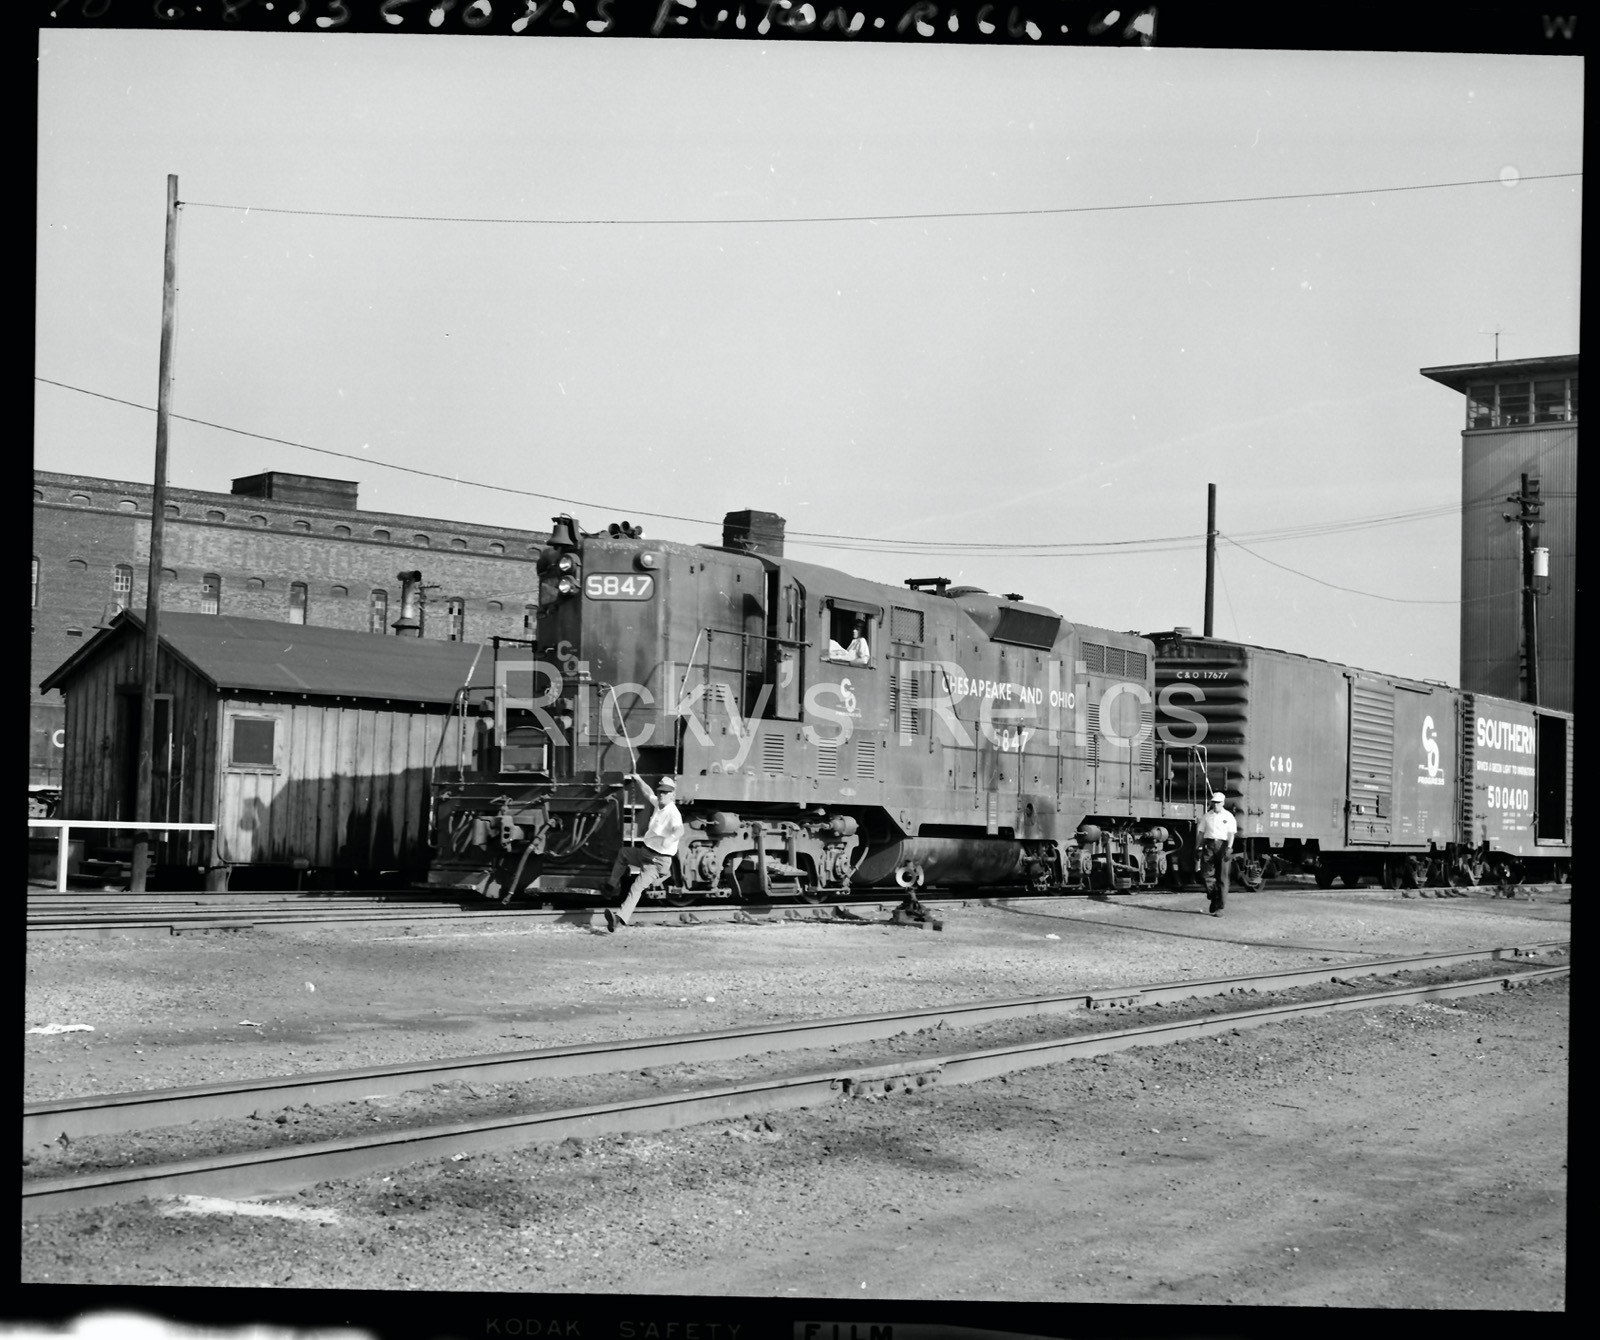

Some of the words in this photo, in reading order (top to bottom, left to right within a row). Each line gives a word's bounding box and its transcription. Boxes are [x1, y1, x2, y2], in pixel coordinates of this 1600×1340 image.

[1541, 14, 1578, 40] W
[587, 575, 653, 596] 5847
[1203, 671, 1229, 679] 17677
[941, 674, 1012, 702] CHESAPEAKE
[1019, 686, 1043, 705] AND
[1049, 690, 1075, 709] OHIO
[993, 728, 1030, 753] 5847
[1476, 716, 1535, 755] SOUTHERN
[1269, 781, 1293, 798] 17677
[1487, 785, 1529, 811] 500400
[485, 1317, 582, 1337] KODAK
[619, 1321, 743, 1339] SAFETY
[804, 1322, 895, 1340] FILM
